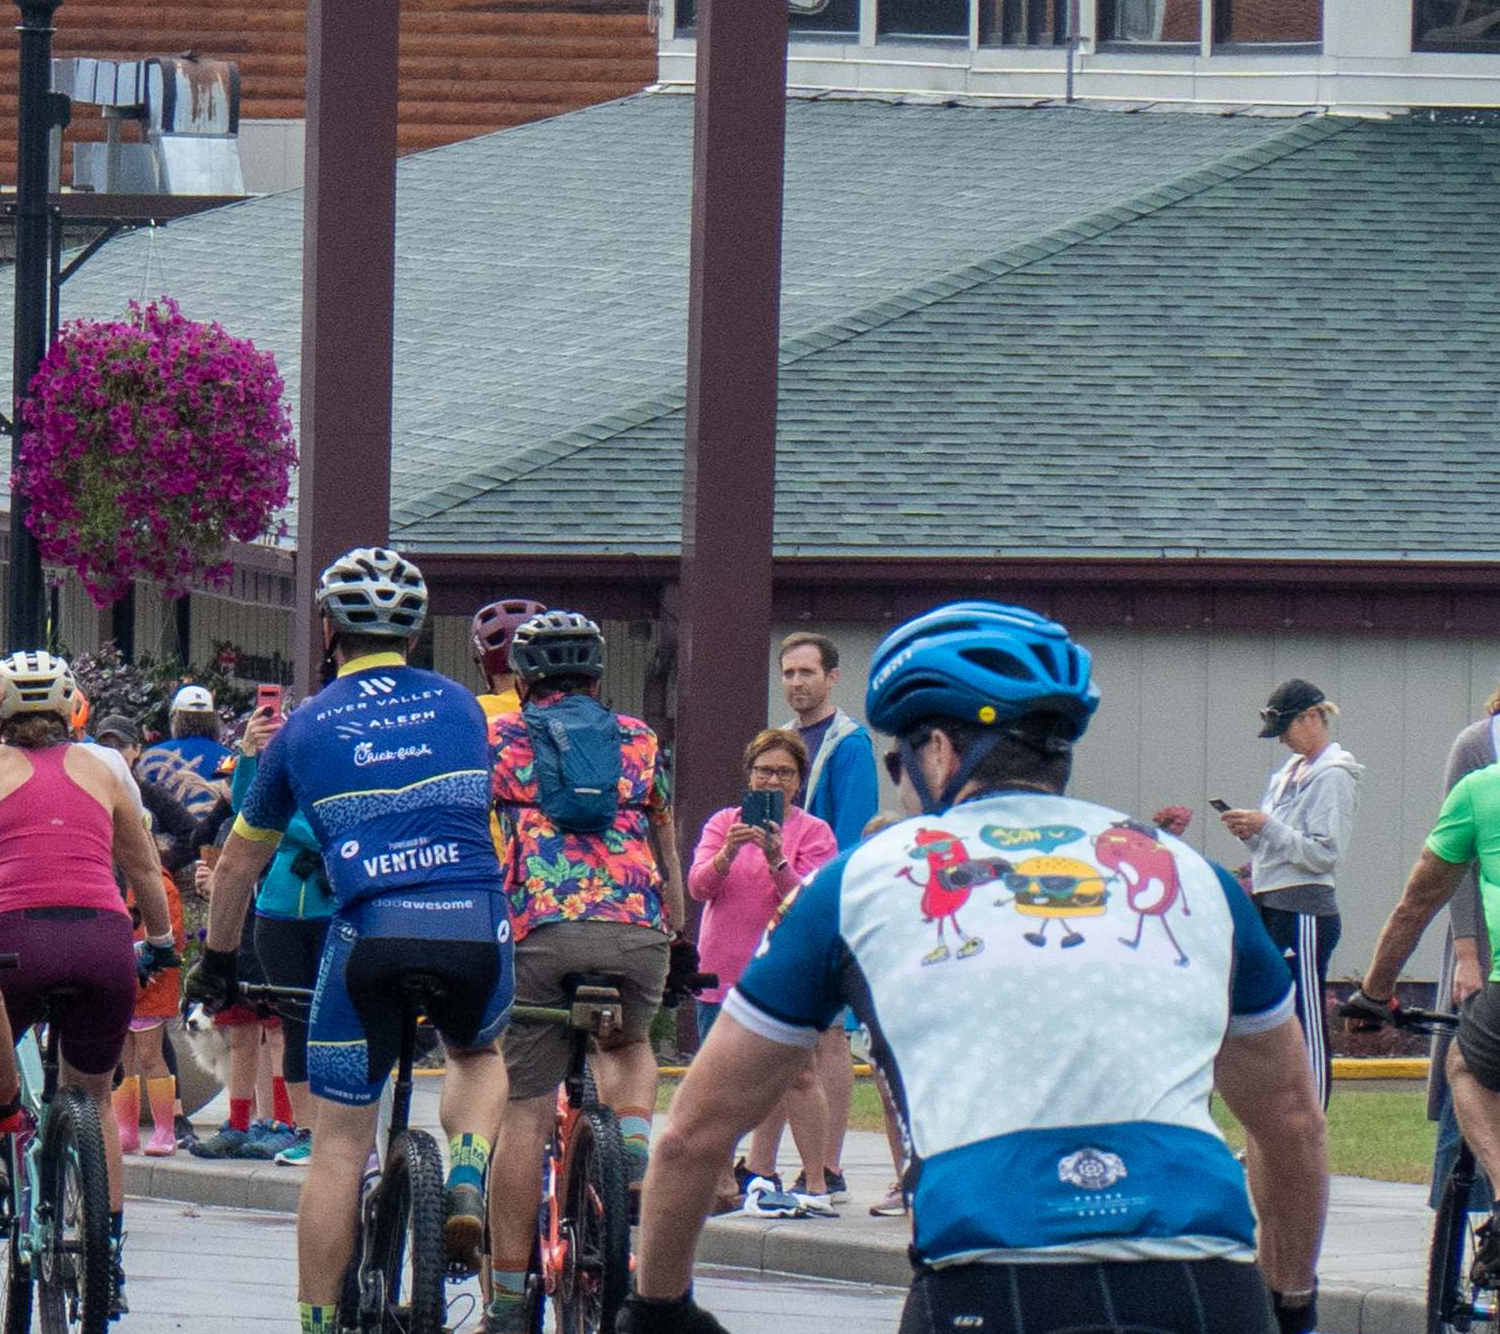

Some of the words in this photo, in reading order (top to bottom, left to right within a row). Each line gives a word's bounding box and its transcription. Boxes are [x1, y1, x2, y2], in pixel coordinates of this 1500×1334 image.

[316, 702, 368, 721] RIVER
[376, 689, 444, 707] VALLEY
[369, 710, 436, 729] ALEPH
[364, 843, 461, 878] VENTURE
[372, 898, 475, 911] dadawesome
